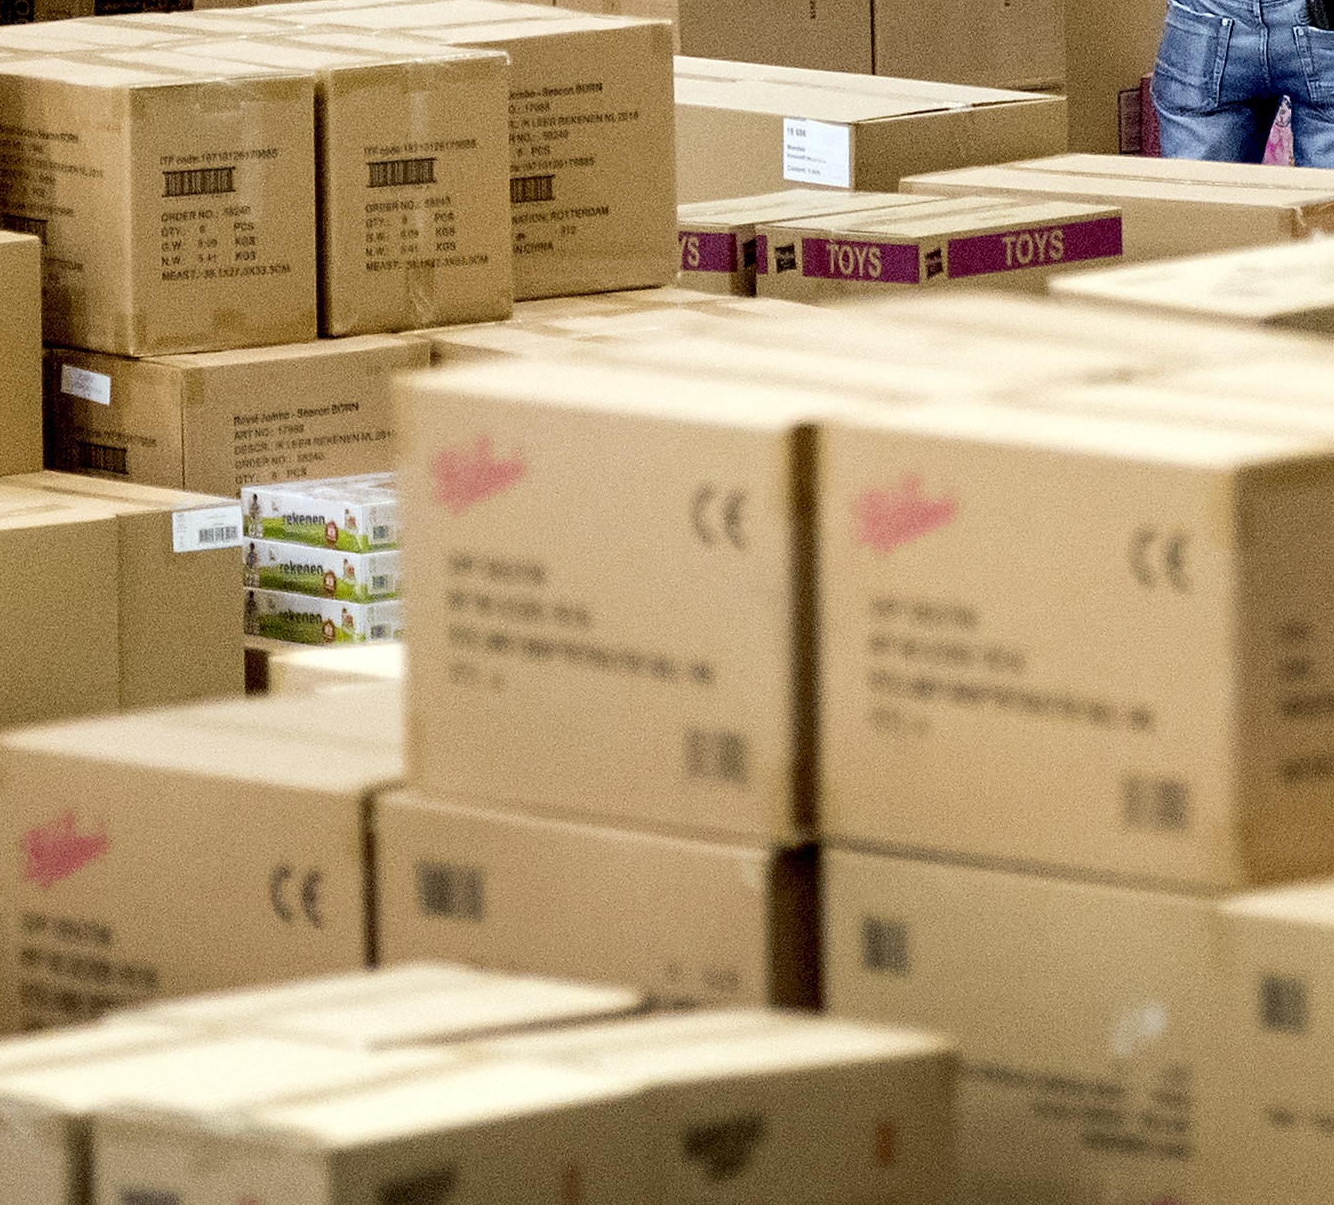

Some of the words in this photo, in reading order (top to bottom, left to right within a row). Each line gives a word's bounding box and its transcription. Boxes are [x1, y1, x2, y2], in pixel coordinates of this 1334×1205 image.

[826, 242, 883, 277] TOYS
[1001, 230, 1066, 266] TOYS
[282, 512, 326, 526] rekenen
[279, 561, 325, 574] rekenen
